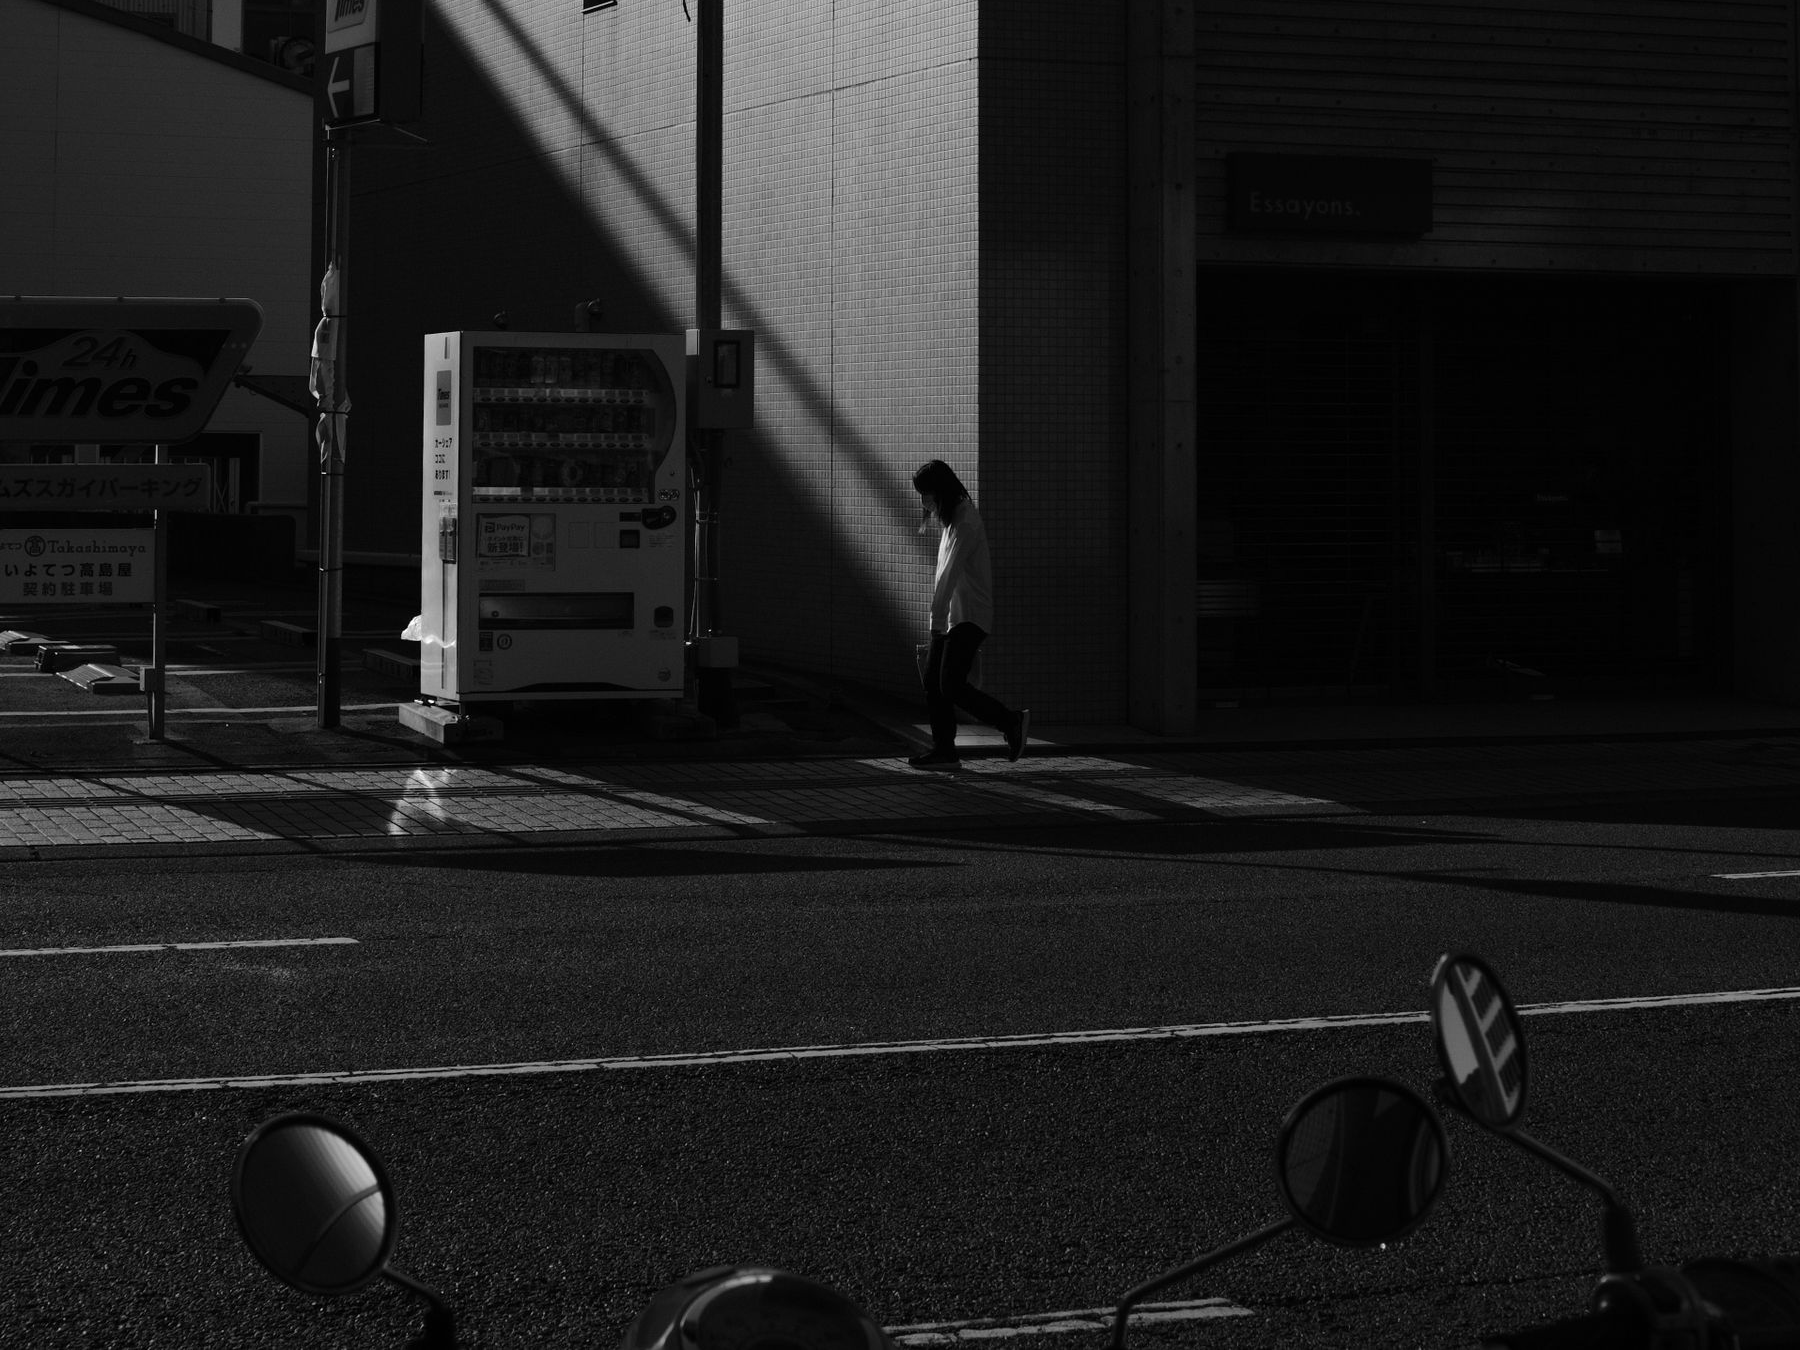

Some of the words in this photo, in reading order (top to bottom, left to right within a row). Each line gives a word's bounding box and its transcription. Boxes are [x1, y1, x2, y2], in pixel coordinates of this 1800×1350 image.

[62, 336, 137, 369] 24h
[0, 356, 199, 418] imes
[496, 523, 526, 532] PayPay
[47, 540, 147, 557] Takashimaya
[4, 562, 132, 577] いよてつ高島屋
